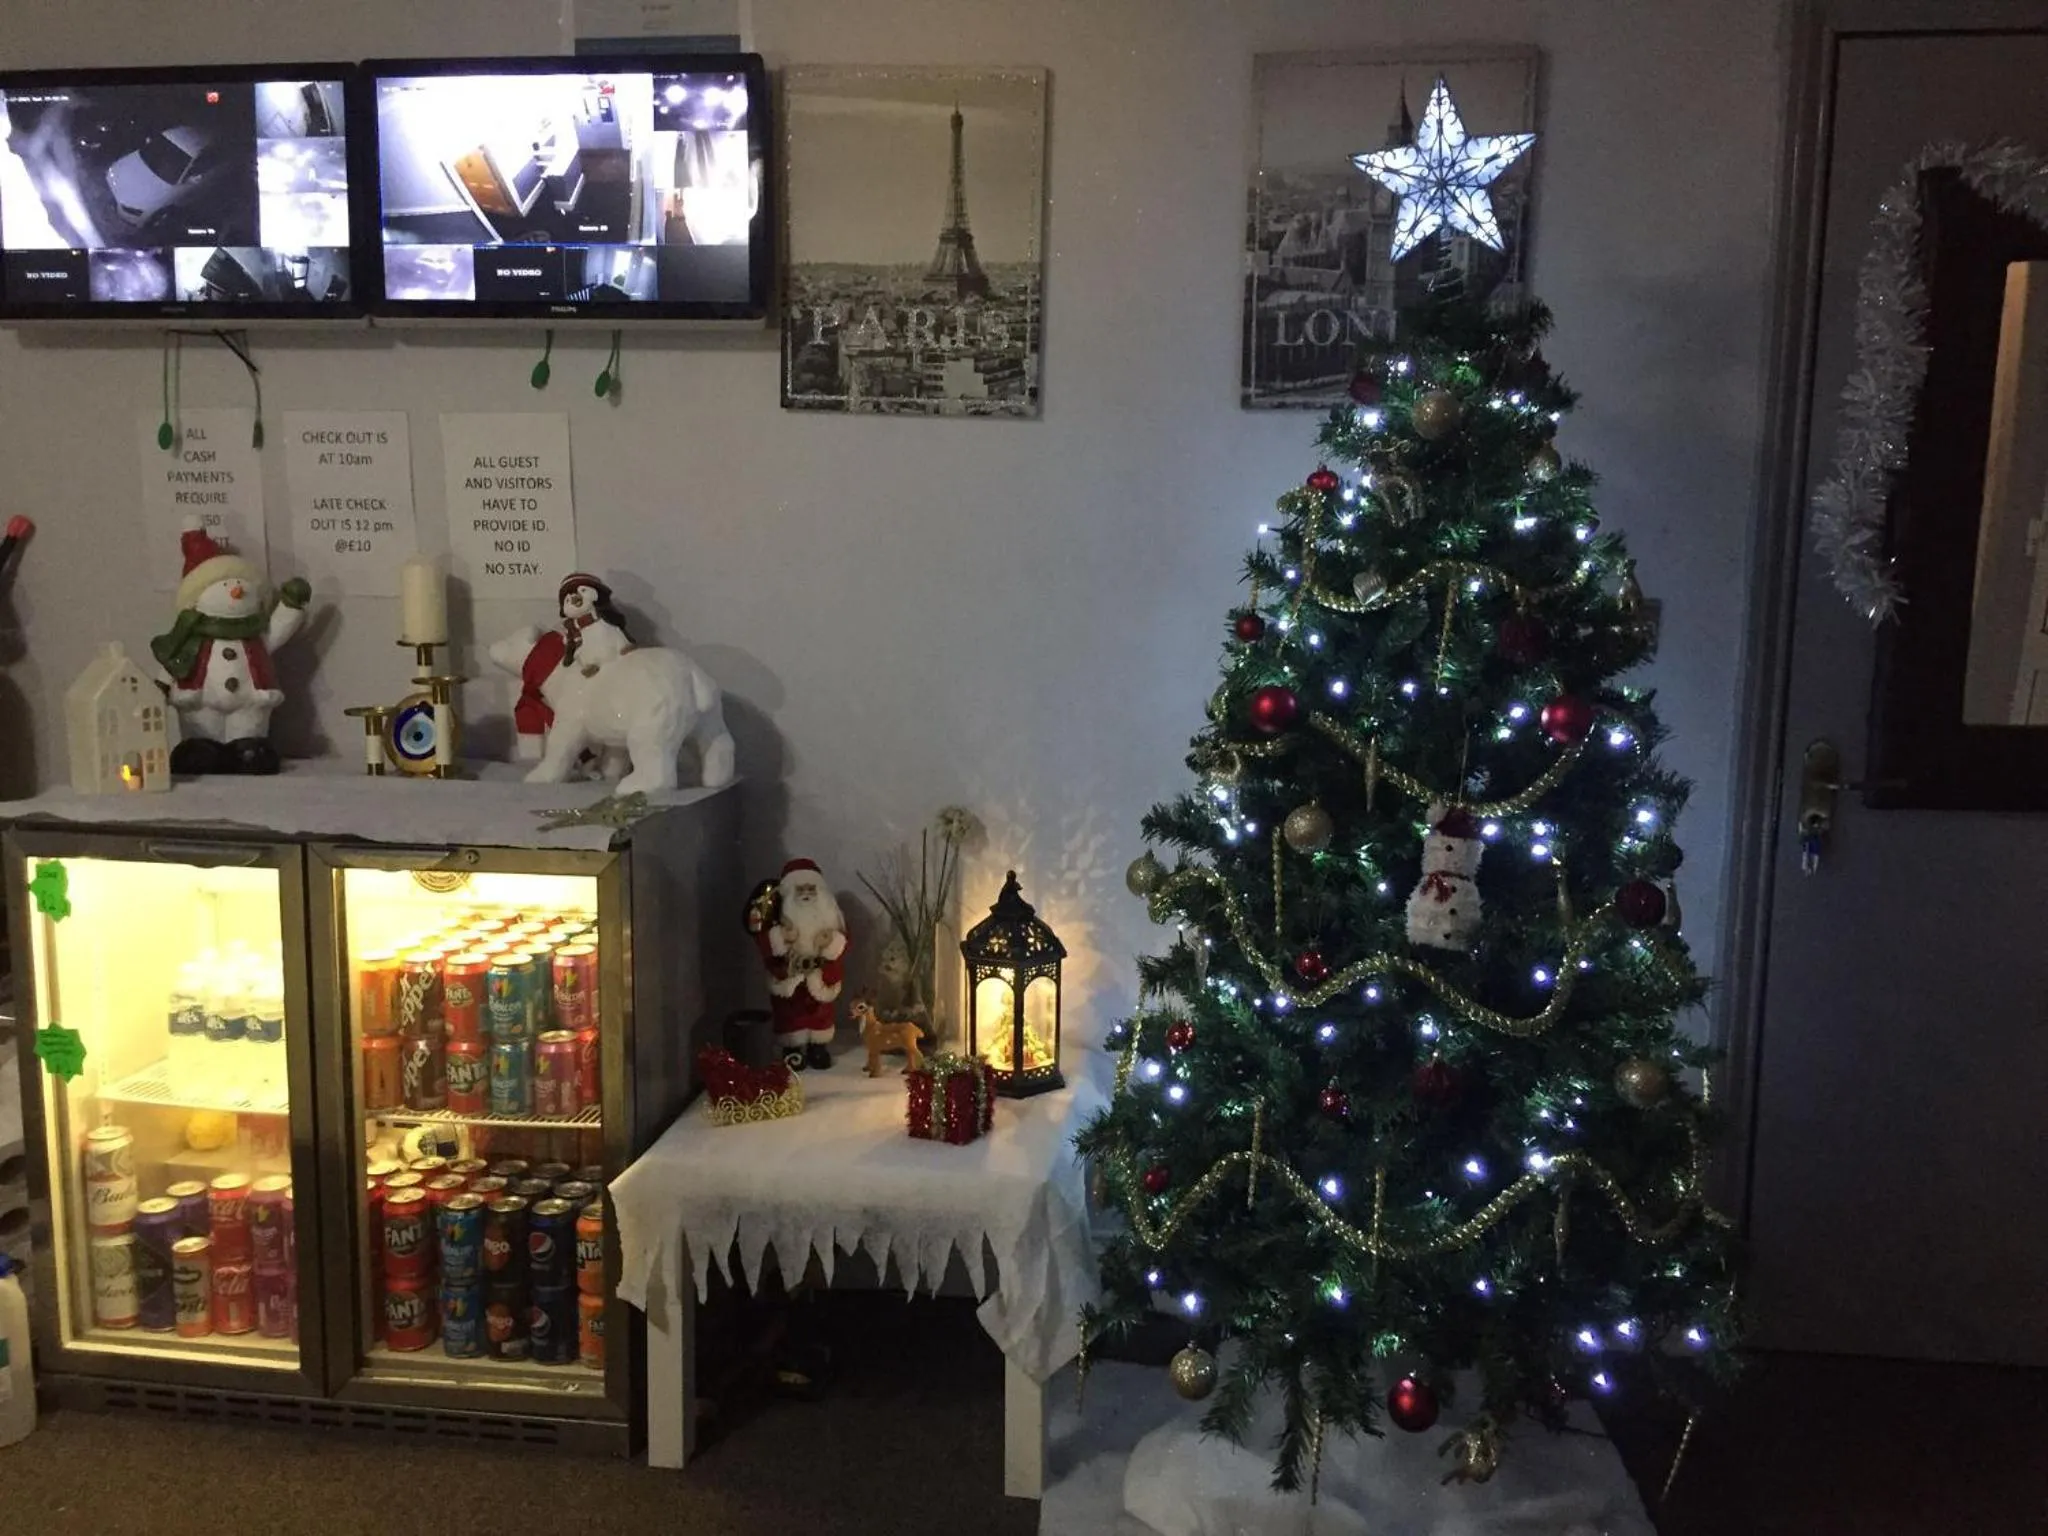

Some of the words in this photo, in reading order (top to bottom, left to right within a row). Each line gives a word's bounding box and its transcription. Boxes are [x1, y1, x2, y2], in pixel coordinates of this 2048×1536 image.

[808, 304, 1010, 350] PARIS
[1271, 308, 1398, 346] LON
[186, 427, 207, 440] ALL
[302, 431, 343, 444] CHECK
[346, 431, 373, 444] OUT
[376, 431, 389, 444] IS
[183, 450, 217, 463] CASH
[319, 452, 335, 465] AT
[340, 452, 373, 465] 10am
[473, 456, 496, 469] ALL
[498, 456, 540, 469] GUEST
[166, 471, 235, 483] PAYMENTS
[465, 477, 493, 490] AND
[495, 477, 553, 490] VISITORS
[175, 492, 229, 505] REQUIRE
[313, 498, 343, 511] LATE
[346, 498, 388, 511] CHECK
[482, 498, 517, 512] HAVE
[520, 498, 538, 511] TO
[310, 518, 336, 531] OUT
[341, 518, 352, 531] IS
[356, 519, 370, 531] 12
[373, 521, 394, 533] pm
[473, 519, 529, 533] PROVIDE
[494, 540, 515, 553] NO
[518, 540, 531, 553] ID
[485, 561, 505, 576] NO
